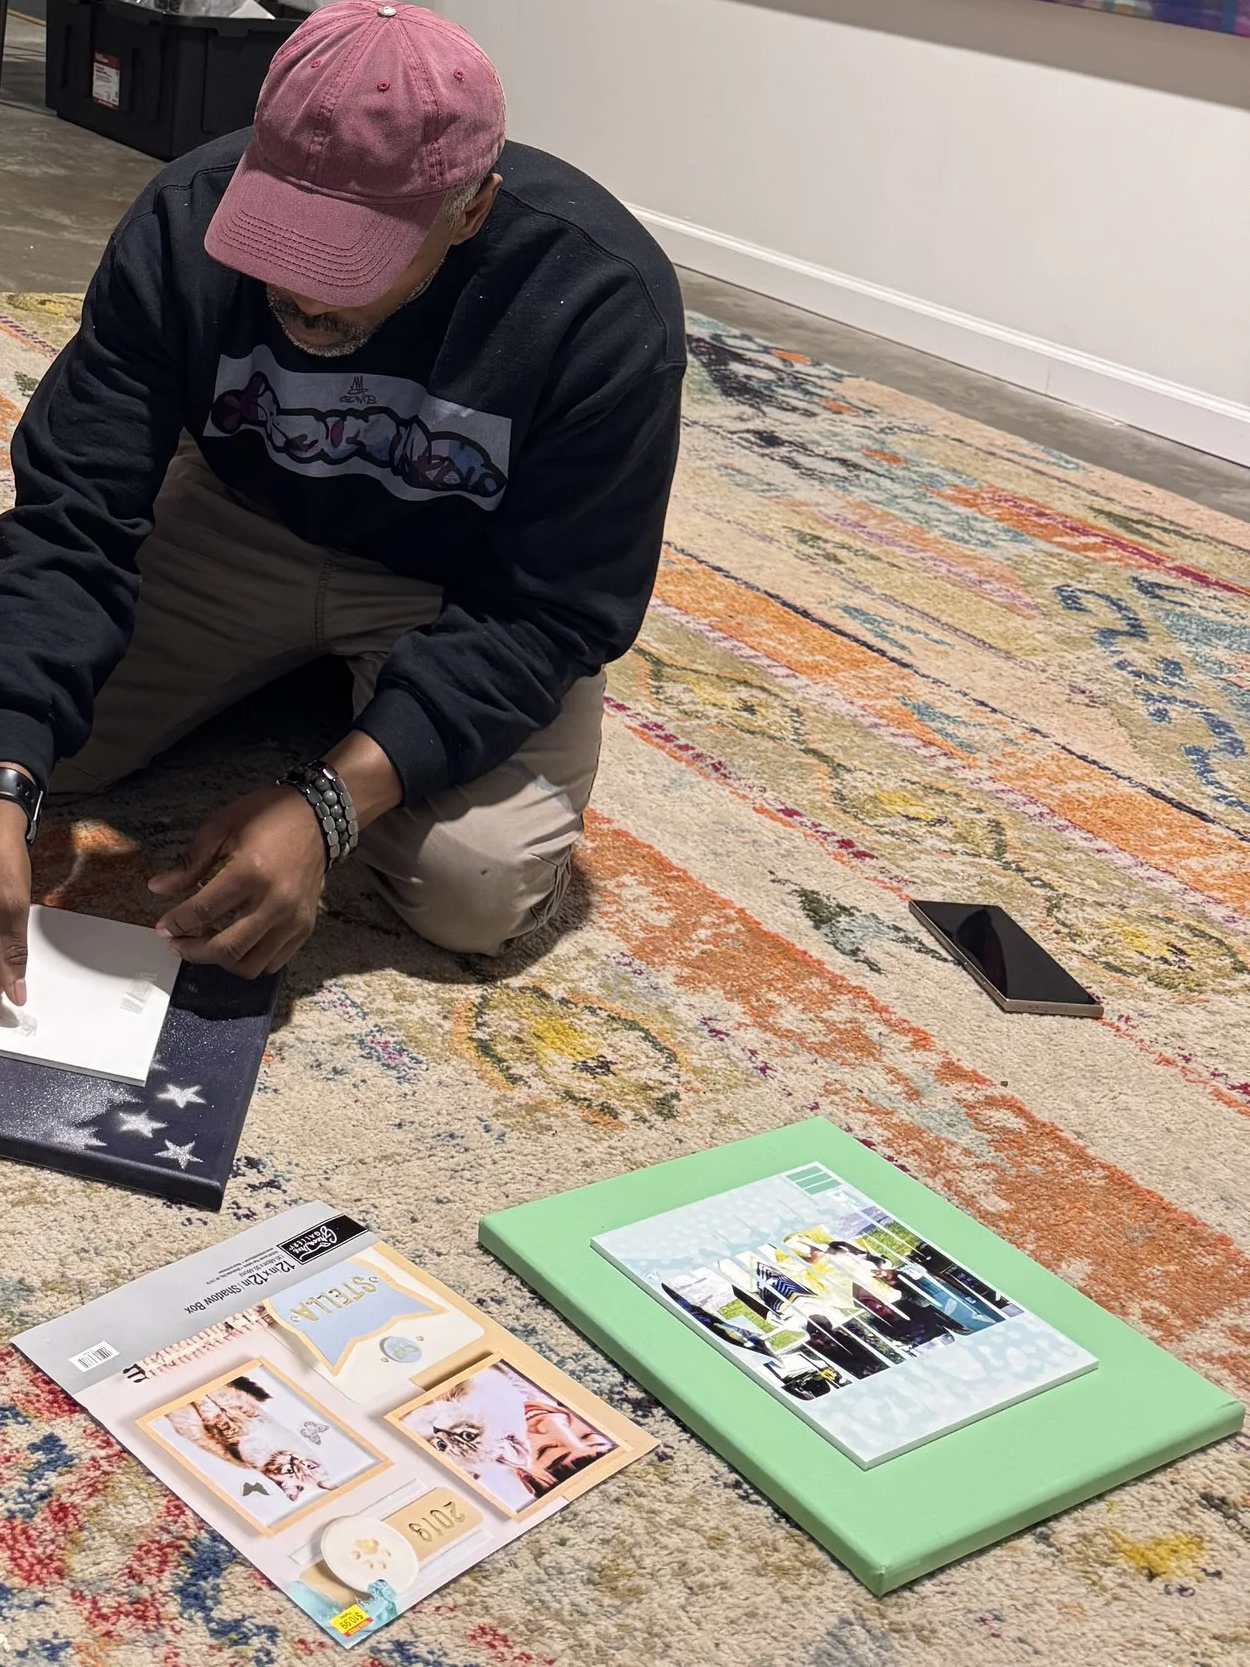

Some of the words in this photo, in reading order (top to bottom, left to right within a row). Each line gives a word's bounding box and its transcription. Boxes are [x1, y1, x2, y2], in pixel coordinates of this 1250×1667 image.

[289, 1231, 321, 1251] GALLERY
[268, 1260, 296, 1274] 12in
[240, 1273, 269, 1286] 12in
[202, 1284, 240, 1306] Shadow
[289, 1276, 377, 1323] STELLA
[184, 1301, 204, 1316] Box
[408, 1501, 466, 1543] 2019
